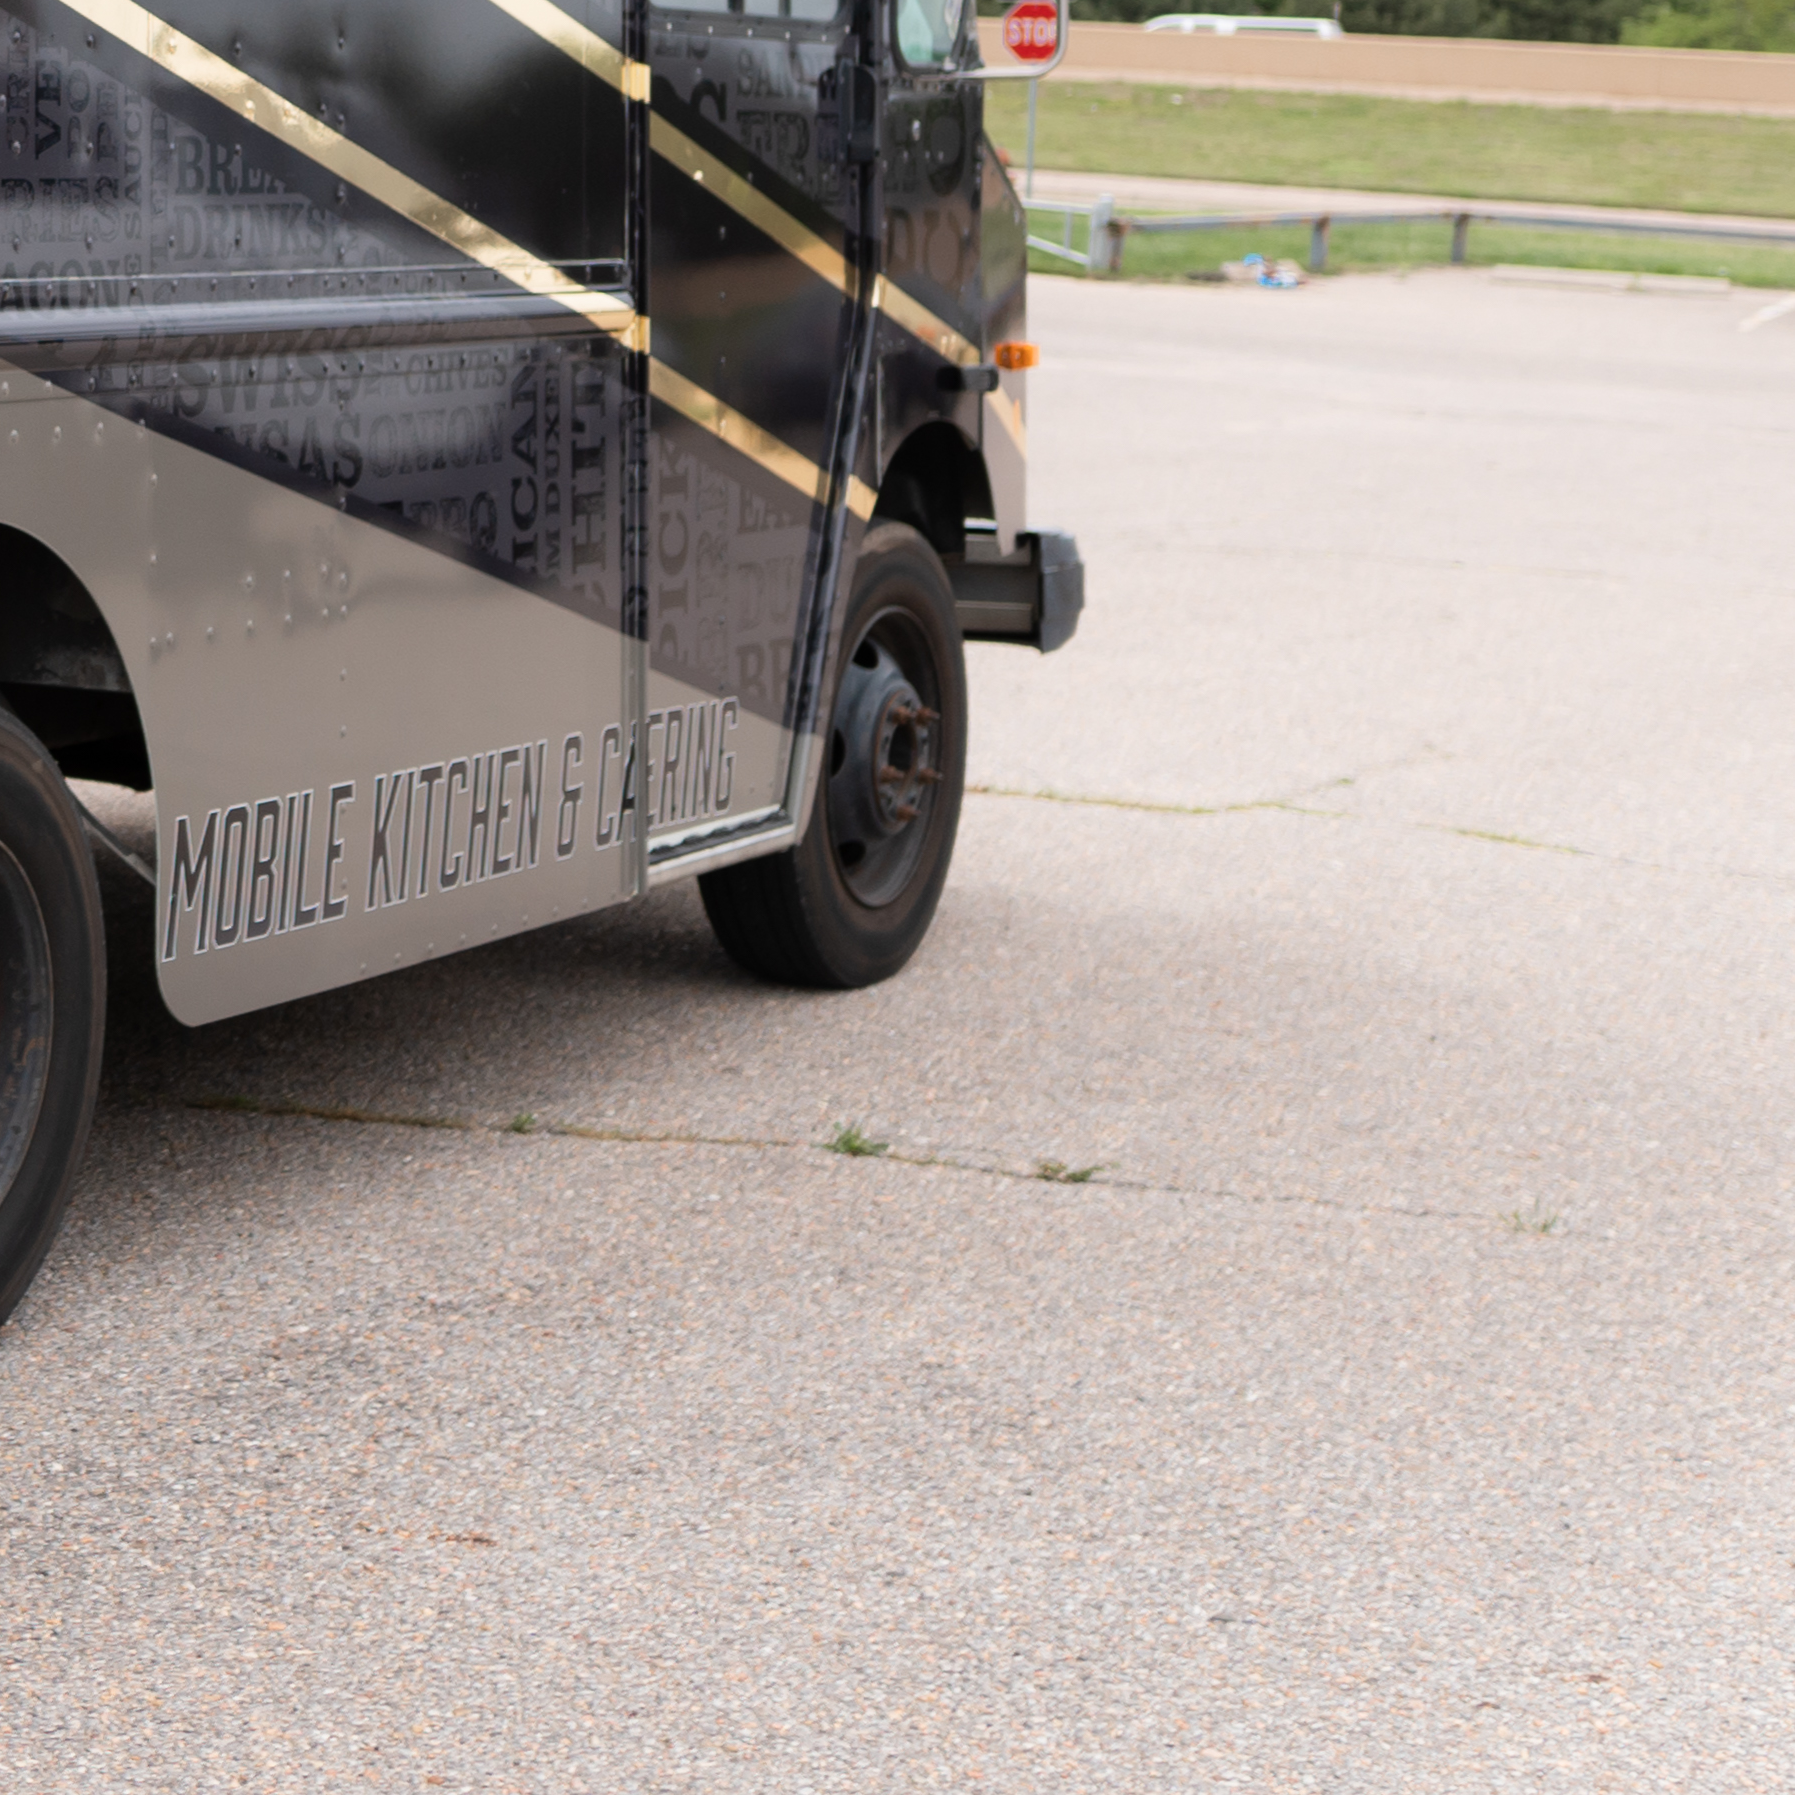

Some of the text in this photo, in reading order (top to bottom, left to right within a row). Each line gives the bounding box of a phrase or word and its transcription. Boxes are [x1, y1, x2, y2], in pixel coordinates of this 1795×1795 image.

[160, 780, 356, 962] MOBILE
[364, 738, 549, 913] KITCHEN
[555, 731, 585, 863] &
